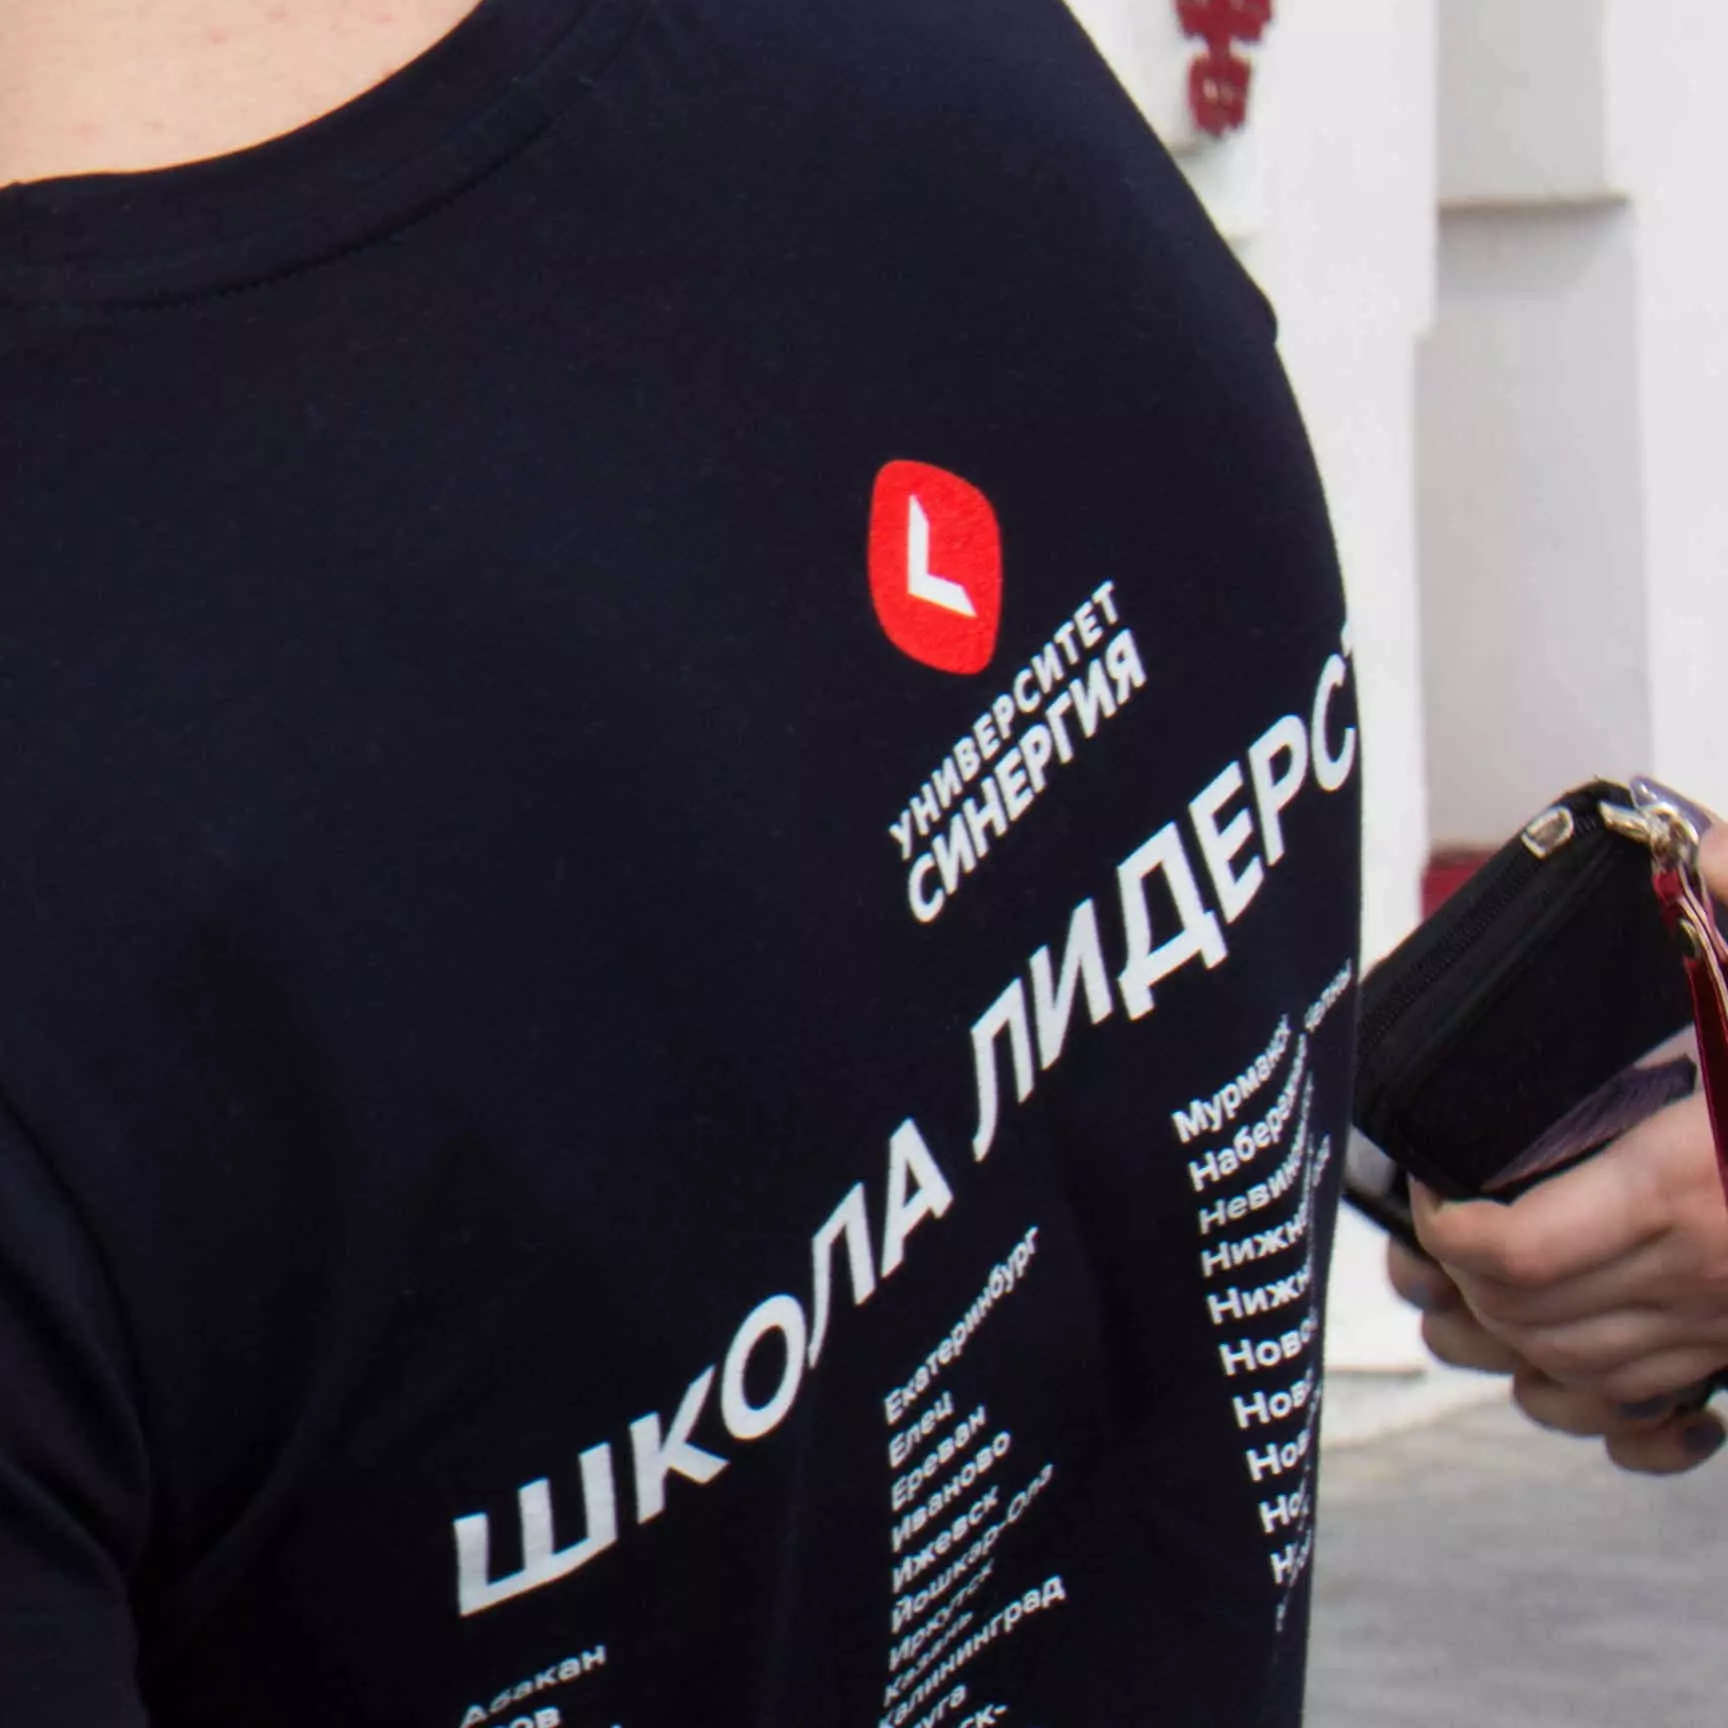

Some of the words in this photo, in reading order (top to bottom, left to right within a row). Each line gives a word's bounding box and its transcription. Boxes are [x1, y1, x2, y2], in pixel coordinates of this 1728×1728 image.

[888, 579, 1120, 861] УНИВЕРСИТЕТ
[907, 627, 1148, 924] СИНЕРГИЯ
[452, 1116, 954, 1618] ШКОЛА
[969, 618, 1356, 1163] ЛИДЕРС
[884, 1225, 1040, 1426] Екатеринбург
[888, 1389, 956, 1469] Елец
[891, 1403, 987, 1513] Ереван
[891, 1430, 1012, 1554] Иваново
[891, 1483, 1000, 1595] Ижевск
[891, 1463, 1055, 1635] Йошкар-Ола
